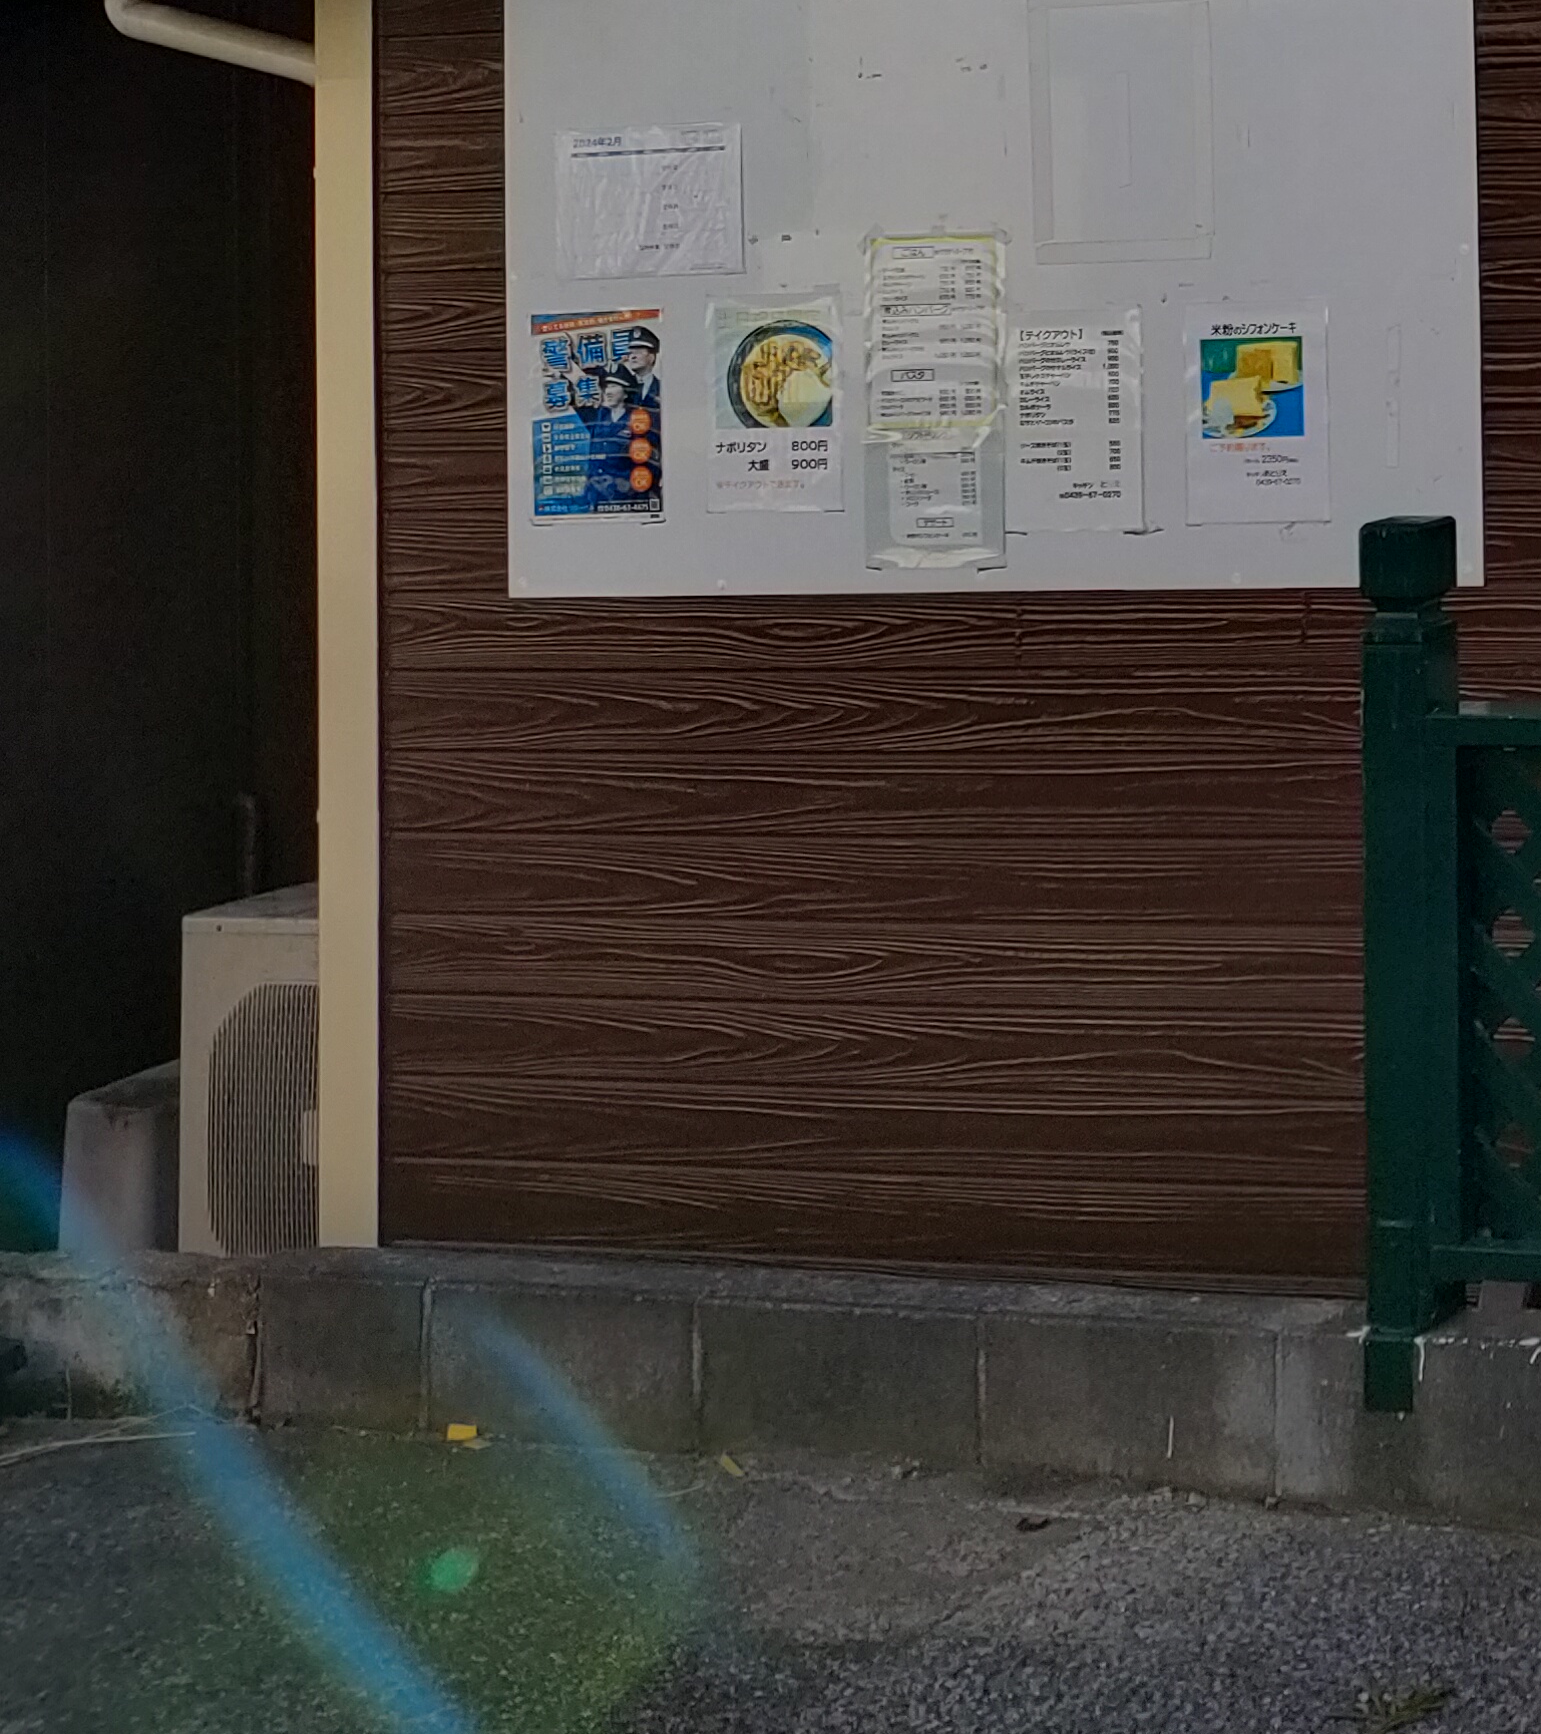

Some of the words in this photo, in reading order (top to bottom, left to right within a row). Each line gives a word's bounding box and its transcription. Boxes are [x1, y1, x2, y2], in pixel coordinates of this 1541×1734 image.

[1211, 322, 1297, 336] 米粉のシフォンケーキ
[543, 376, 600, 411] 募集
[716, 441, 767, 454] ナポリタン
[791, 440, 828, 453] 800円
[748, 459, 769, 471] 大盛
[791, 459, 828, 470] 900円
